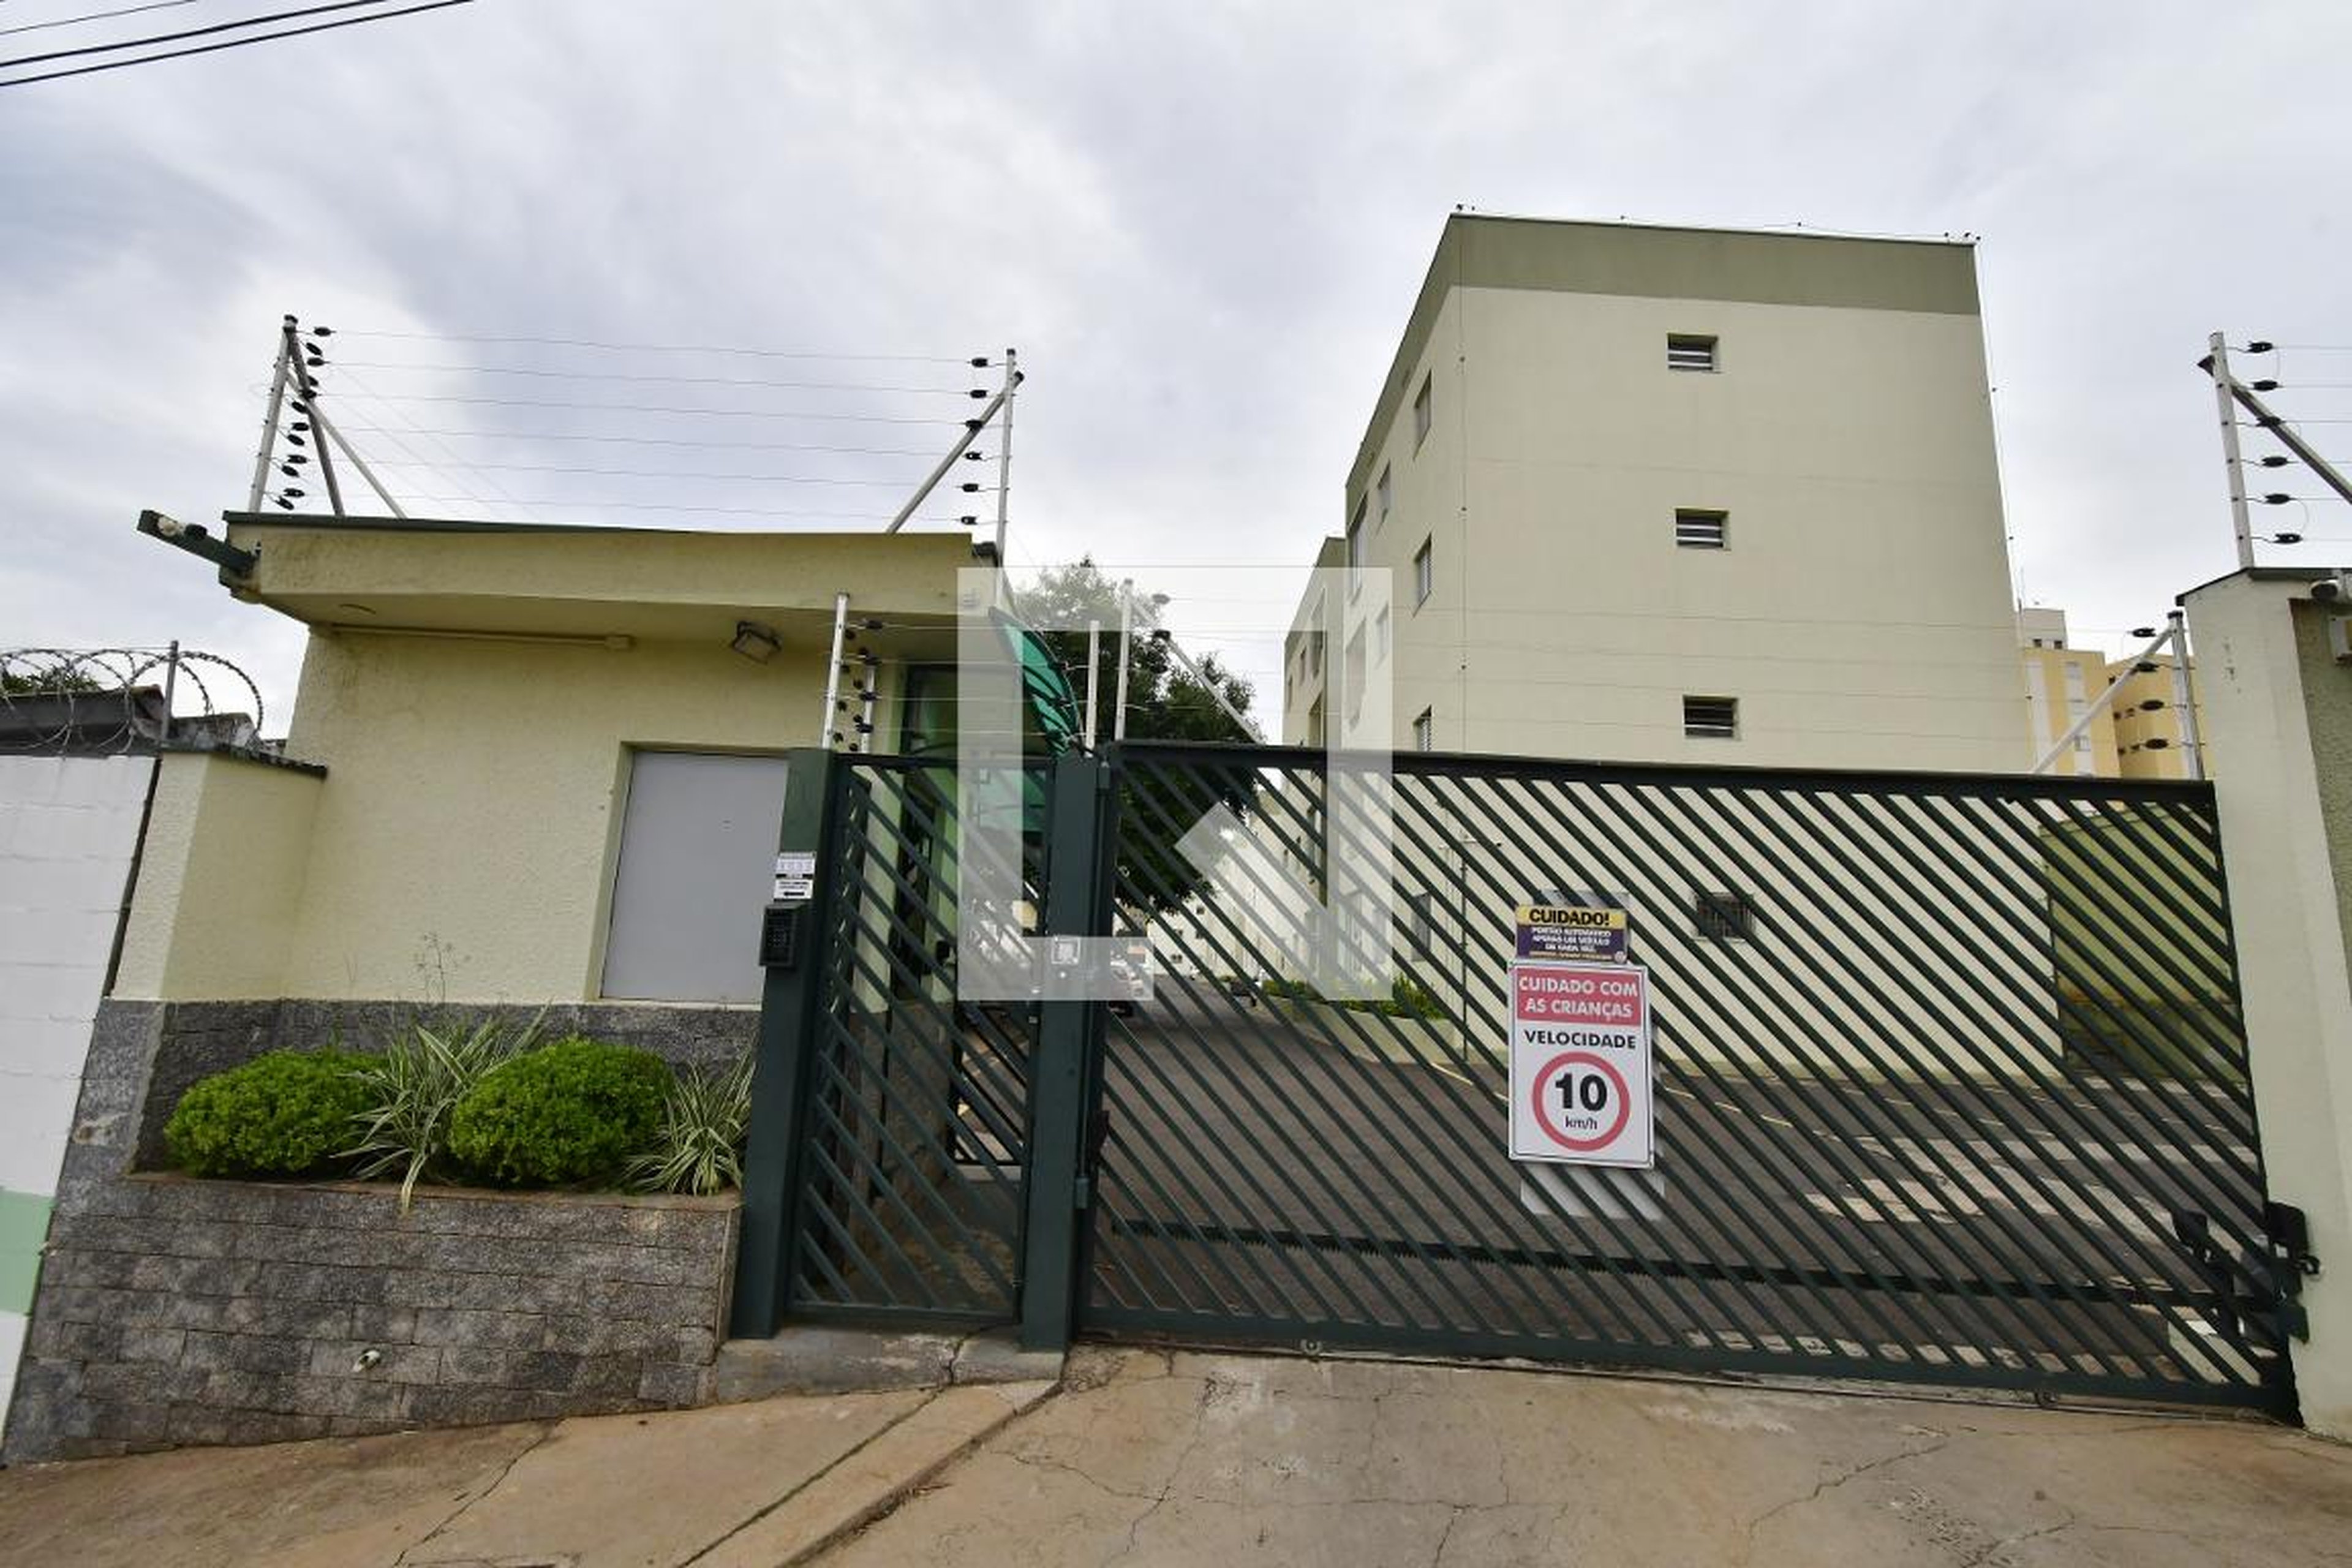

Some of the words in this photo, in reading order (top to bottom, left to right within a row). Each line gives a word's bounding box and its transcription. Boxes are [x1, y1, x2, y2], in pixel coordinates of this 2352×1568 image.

[1529, 909, 1610, 925] CUIDADO!
[1519, 976, 1595, 994] CUIDADO
[1600, 981, 1638, 997] COM
[1525, 998, 1547, 1012] AS
[1551, 1000, 1633, 1022] CRIANÇAS
[1525, 1029, 1636, 1049] VELOCIDADE
[1555, 1072, 1607, 1112] 10
[1566, 1116, 1597, 1129] km/h
